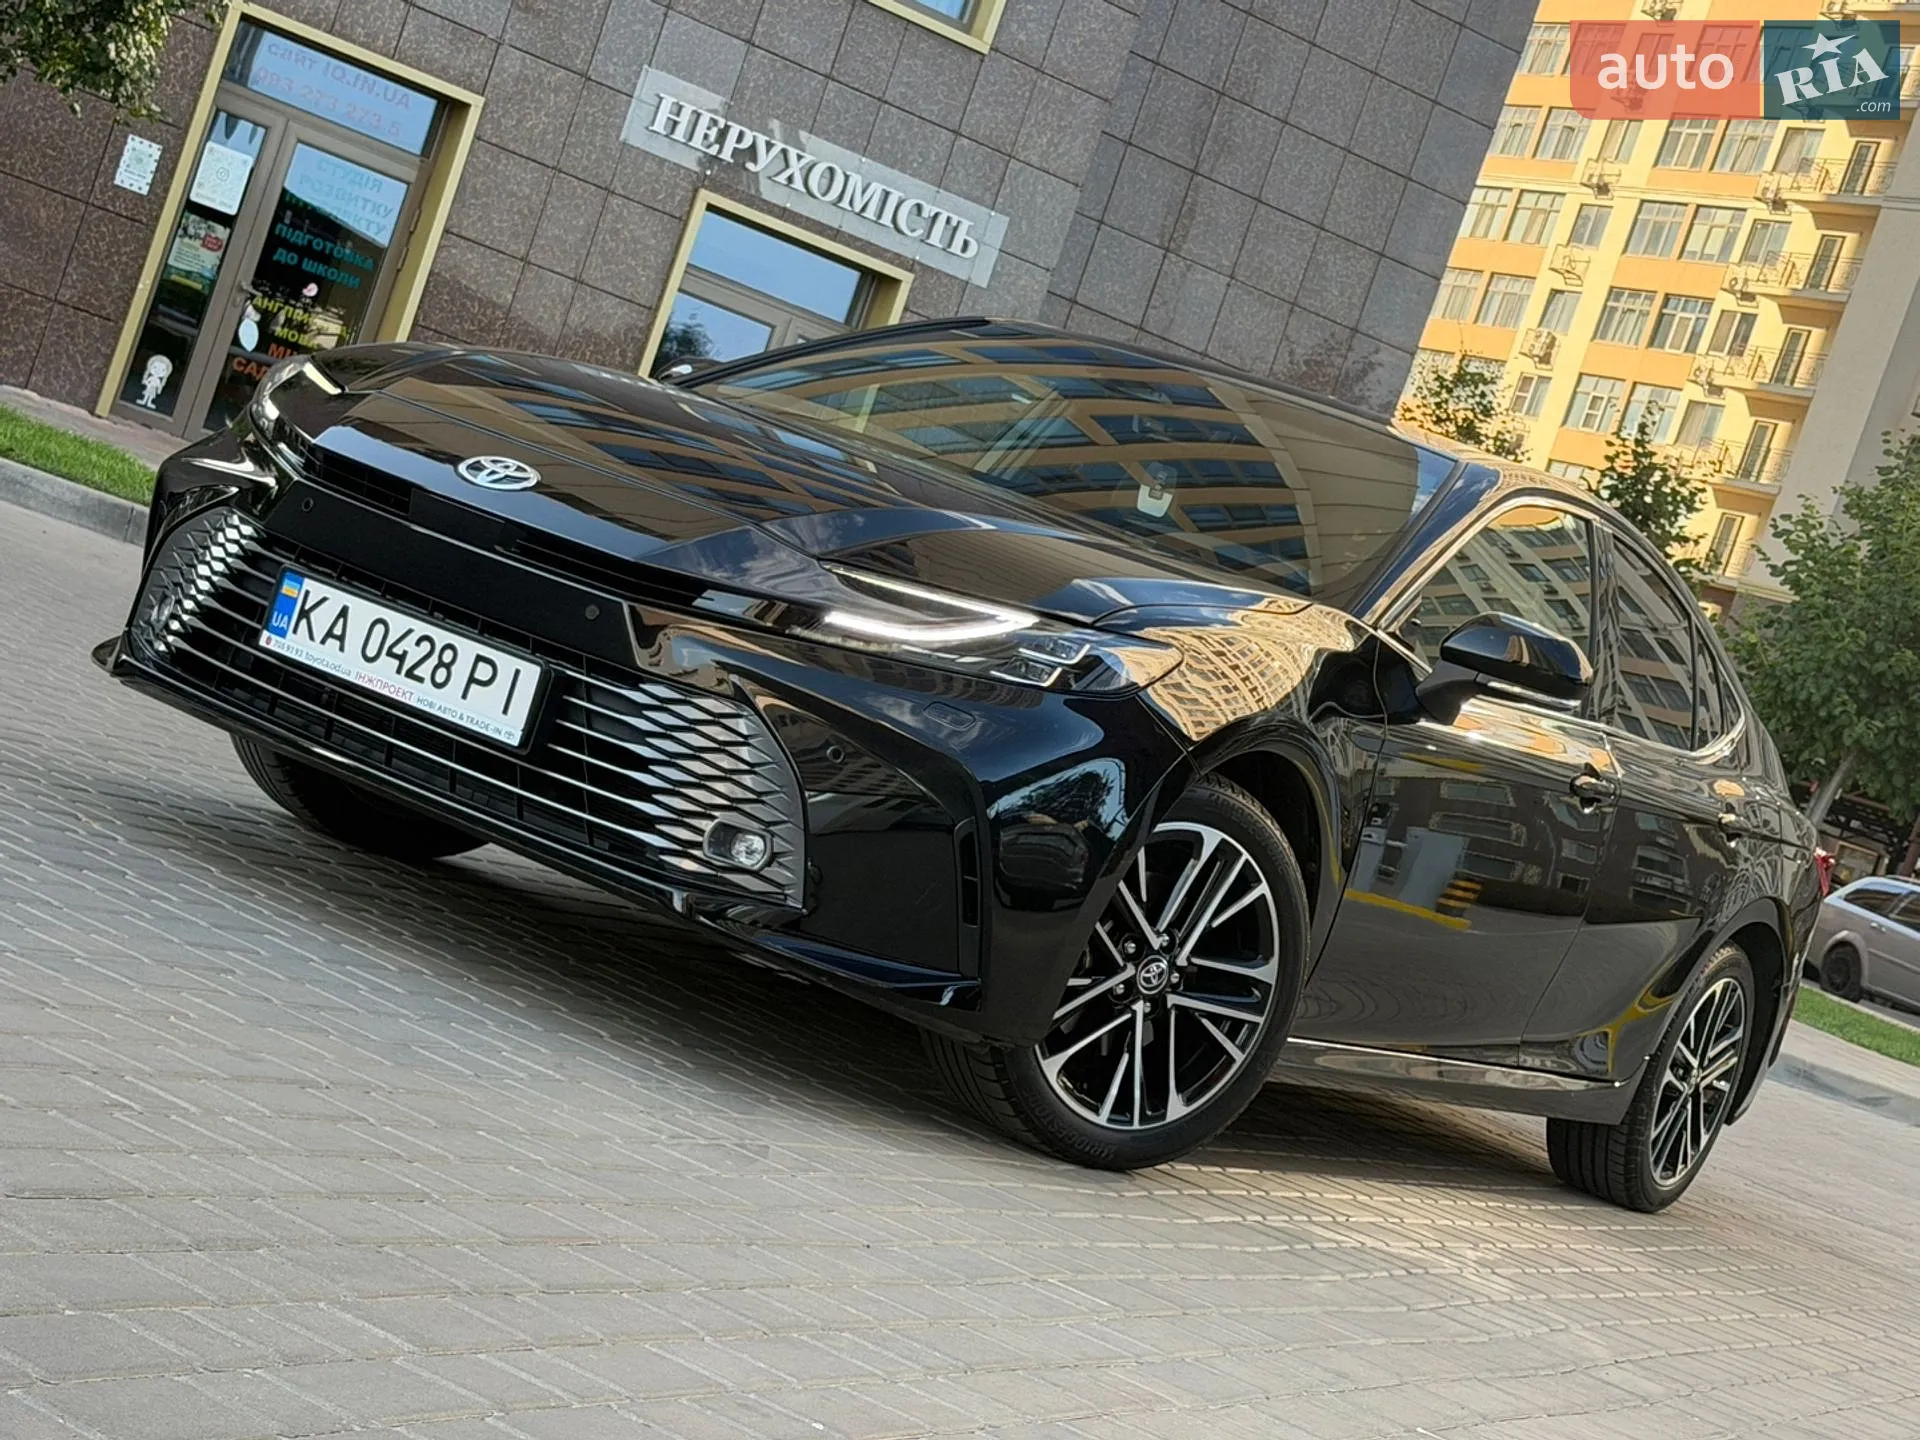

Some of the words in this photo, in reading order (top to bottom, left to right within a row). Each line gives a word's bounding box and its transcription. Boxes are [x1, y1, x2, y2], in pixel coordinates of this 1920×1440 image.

[299, 174, 393, 218] РОЗВИТКУ
[317, 157, 383, 194] СТУДІЯ
[647, 92, 980, 260] НЕРУХОМІСТЬ
[272, 247, 299, 266] ДО
[301, 257, 361, 289] ШКОЛИ
[274, 222, 374, 272] ПІДГОТОВКА
[271, 611, 289, 630] UA
[292, 589, 350, 653] KA
[361, 617, 459, 690] 0428
[461, 653, 521, 716] PI
[355, 671, 414, 700] ІНЖПРОЕКТ
[465, 713, 502, 736] TRADE-IN
